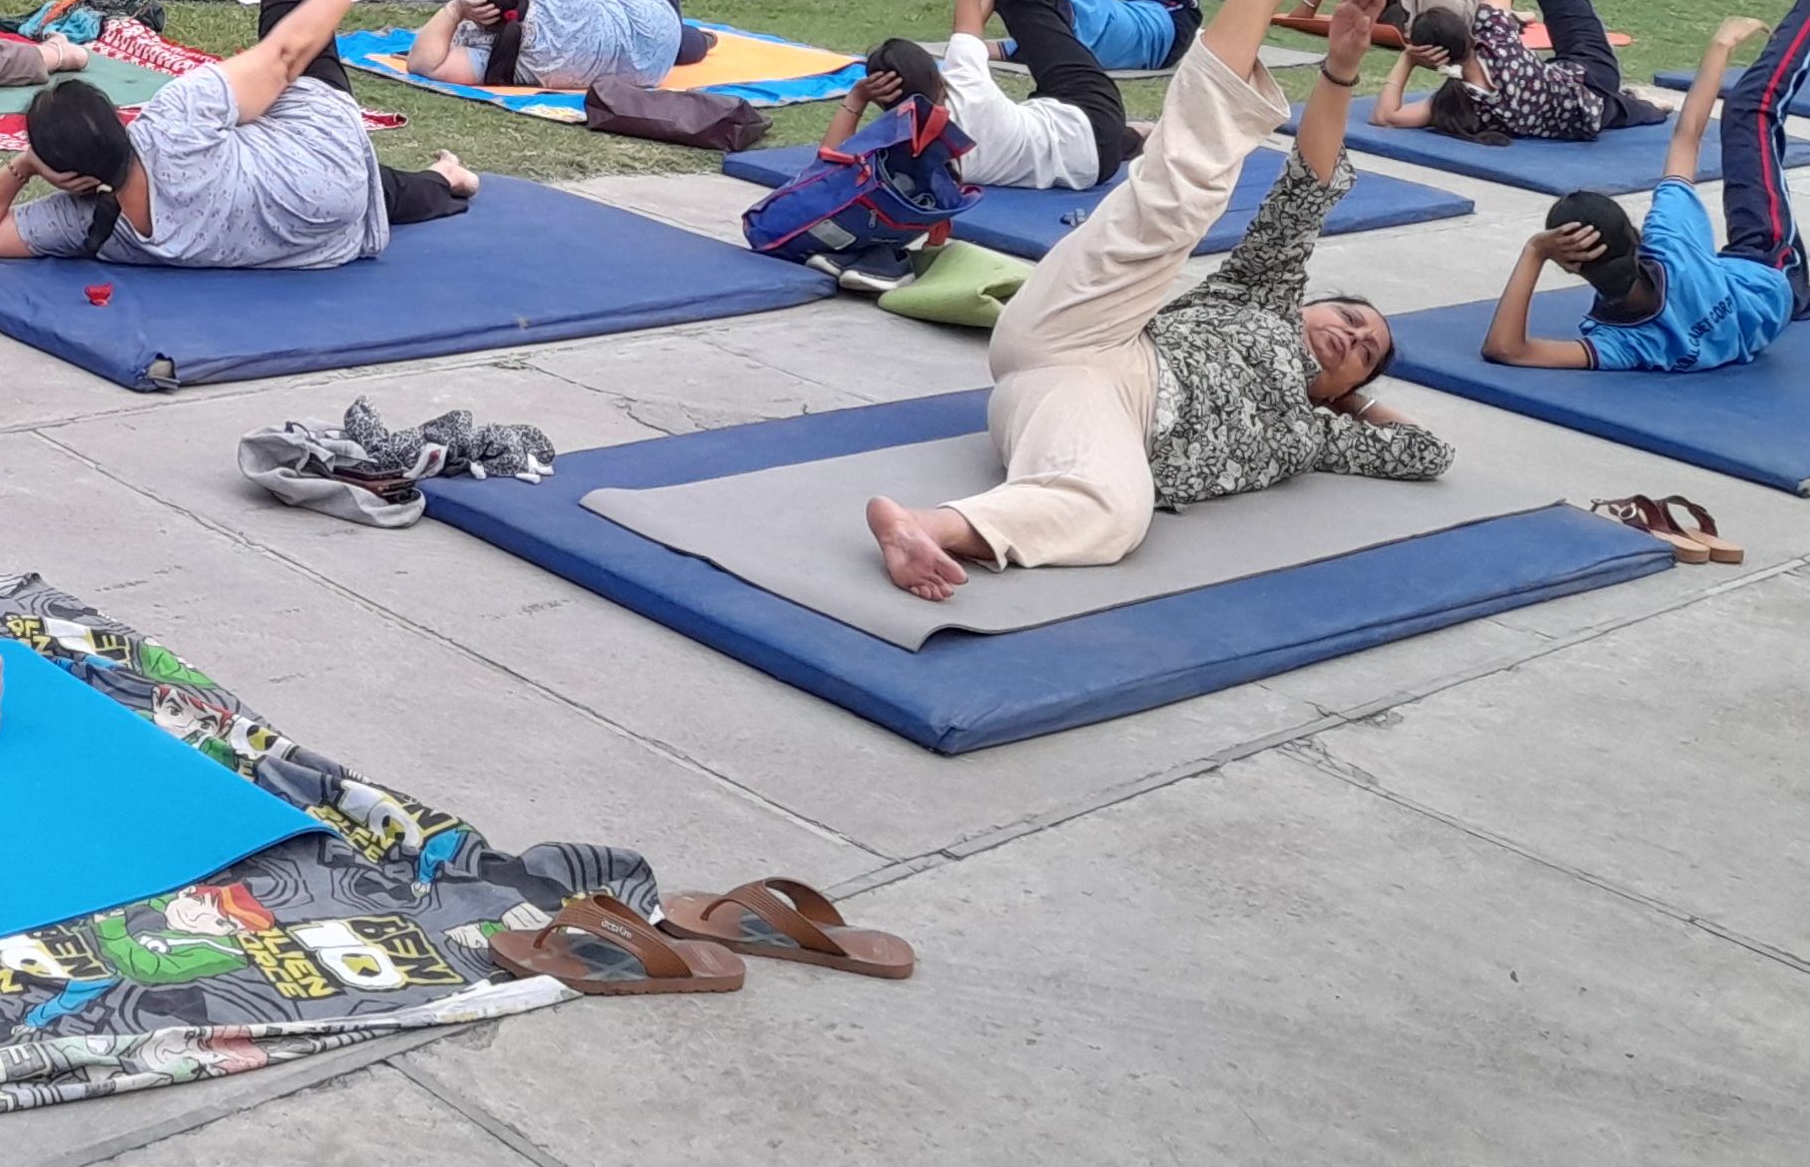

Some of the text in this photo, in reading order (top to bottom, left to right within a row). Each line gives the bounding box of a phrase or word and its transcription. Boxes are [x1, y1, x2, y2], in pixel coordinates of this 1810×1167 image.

[239, 934, 308, 998] ORCE
[286, 919, 405, 990] 10
[346, 914, 467, 985] BEN
